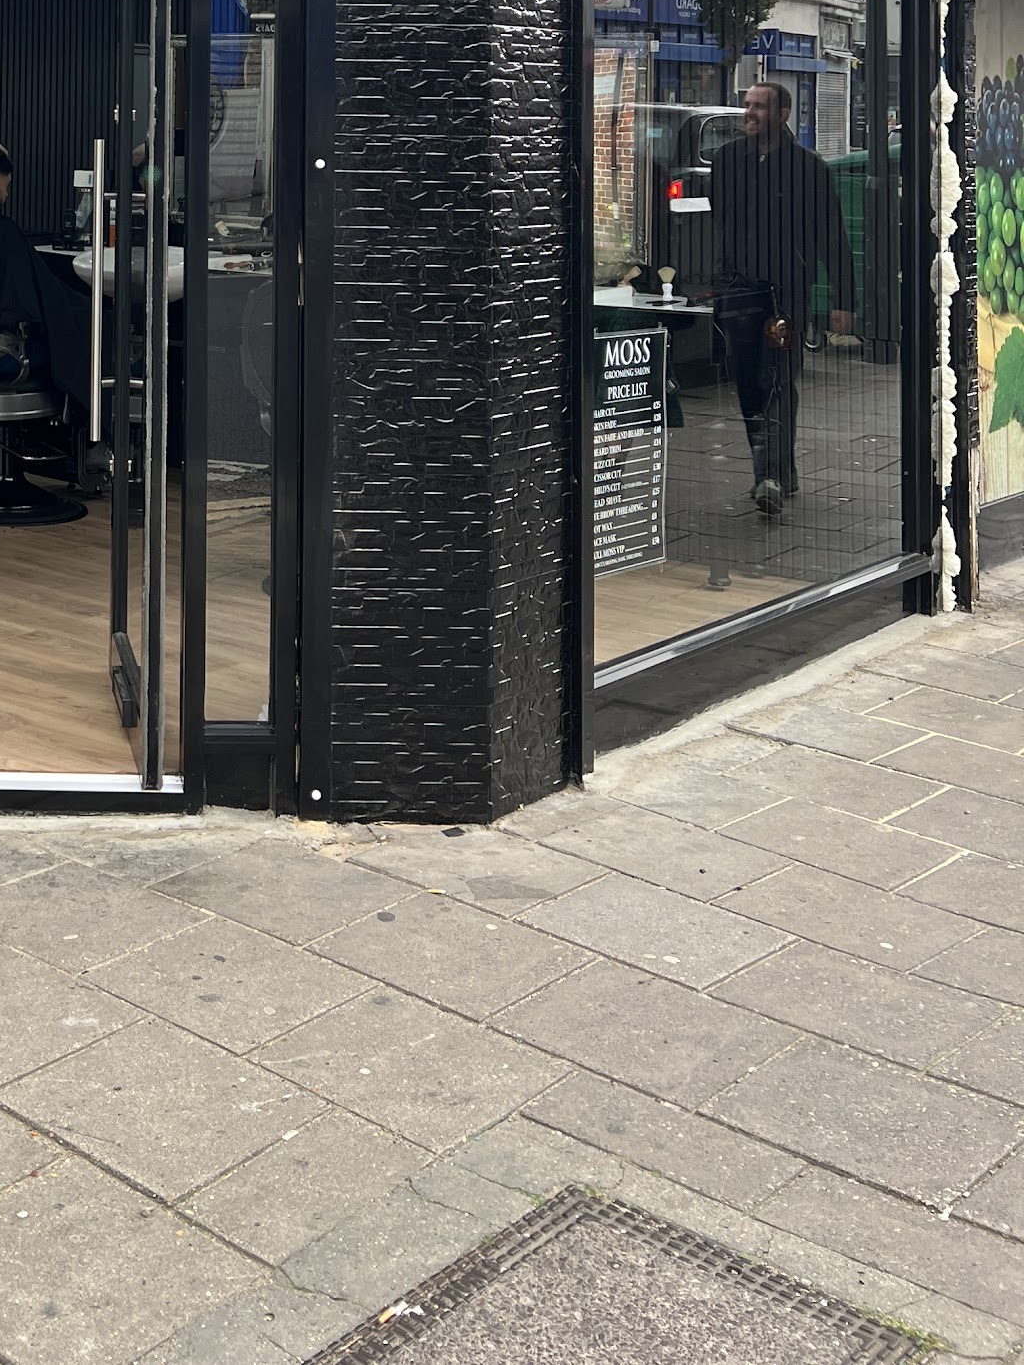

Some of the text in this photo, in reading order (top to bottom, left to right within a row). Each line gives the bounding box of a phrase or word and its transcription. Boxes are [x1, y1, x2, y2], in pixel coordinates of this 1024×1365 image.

[604, 337, 651, 367] MOSS
[604, 366, 651, 380] GROOMING SALON
[607, 382, 648, 400] PRICE LIST
[605, 407, 616, 417] CUT
[605, 420, 617, 430] FADE
[605, 433, 617, 442] FADE
[606, 458, 616, 467] CUT
[594, 472, 612, 483] CISSOR
[612, 469, 622, 479] CUT
[594, 484, 610, 495] HILD'S
[610, 482, 621, 493] CUT
[594, 498, 605, 508] EAD
[594, 551, 603, 560] ULL
